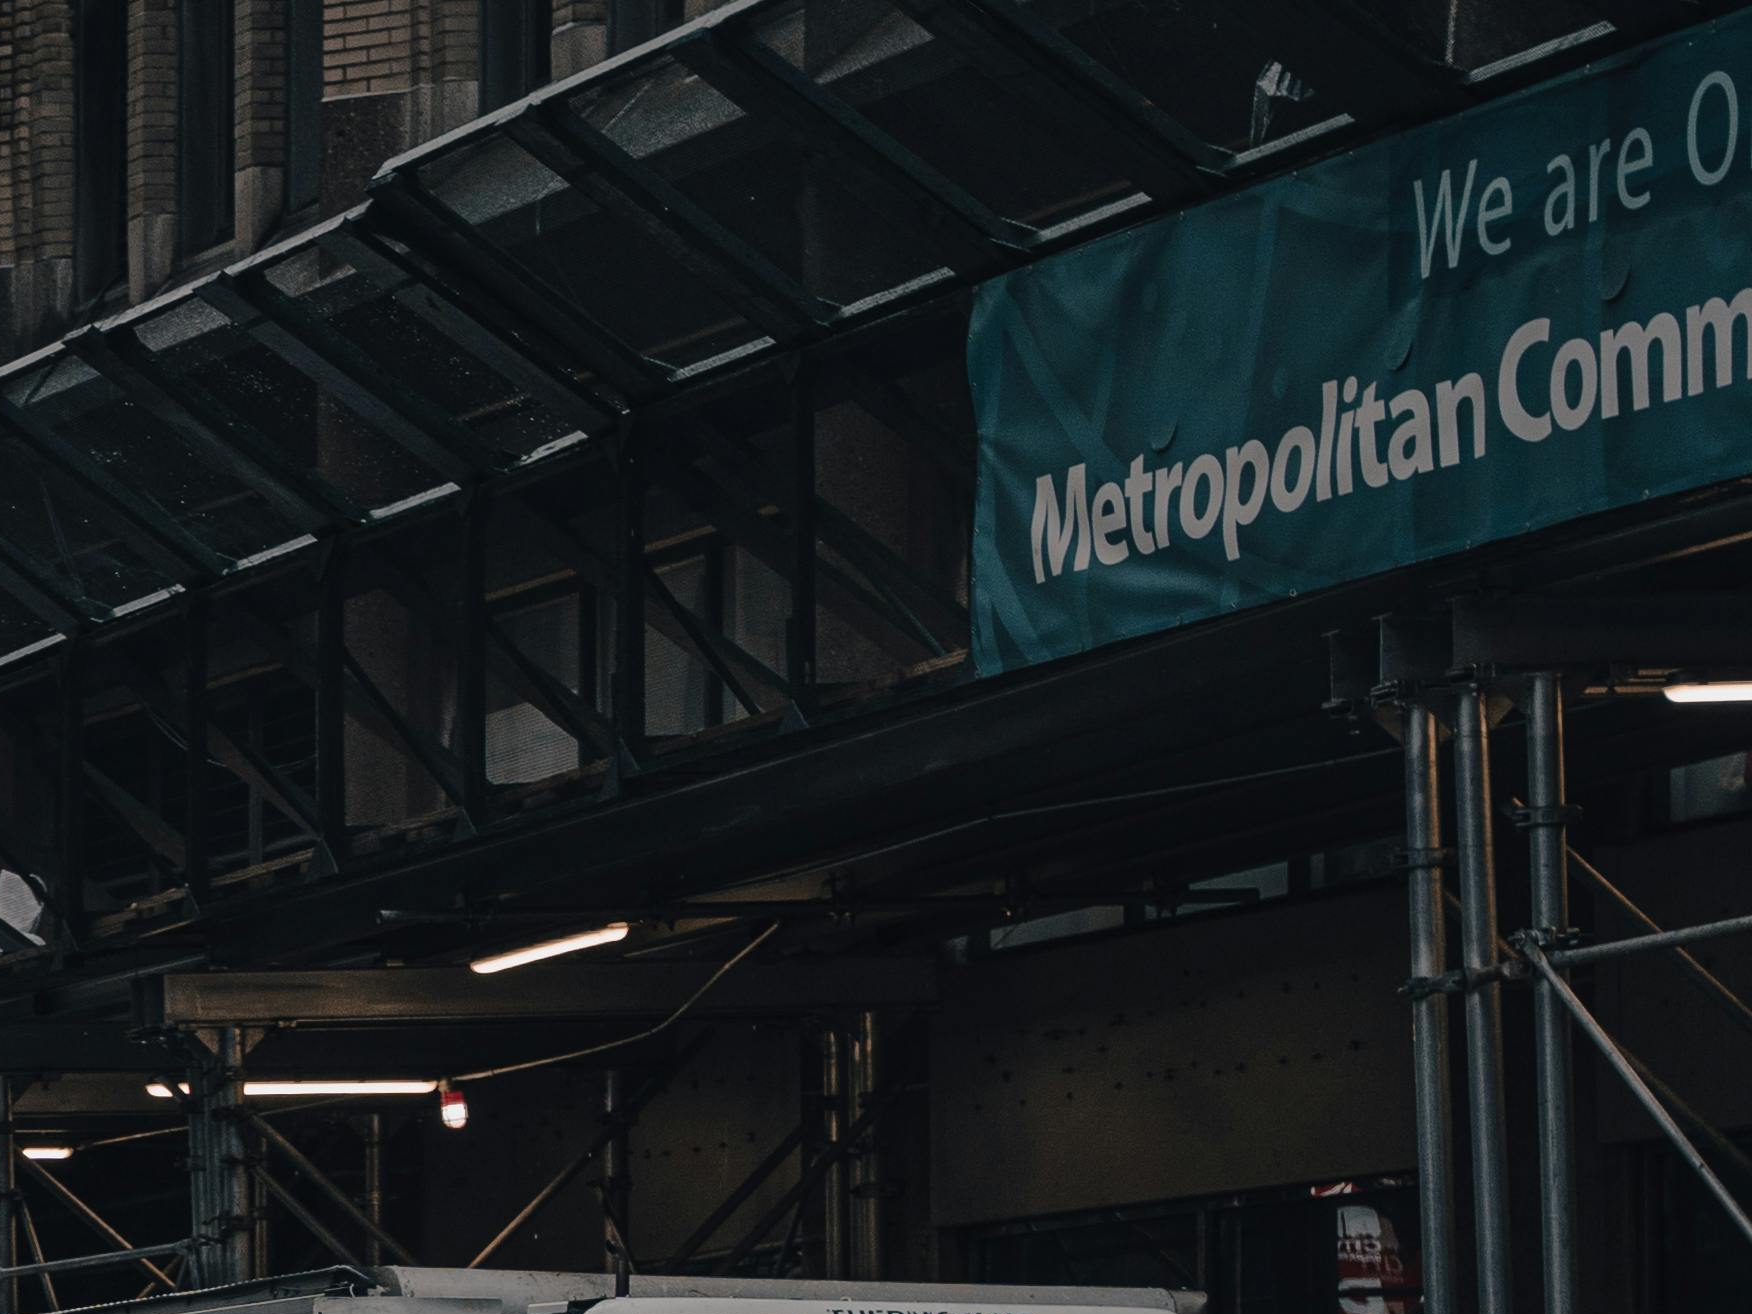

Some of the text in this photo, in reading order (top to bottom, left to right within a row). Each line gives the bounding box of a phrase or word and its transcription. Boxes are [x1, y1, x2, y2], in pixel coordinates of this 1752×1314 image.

[1412, 70, 1752, 280] We are O
[1029, 286, 1752, 585] Metropolitan Comm
